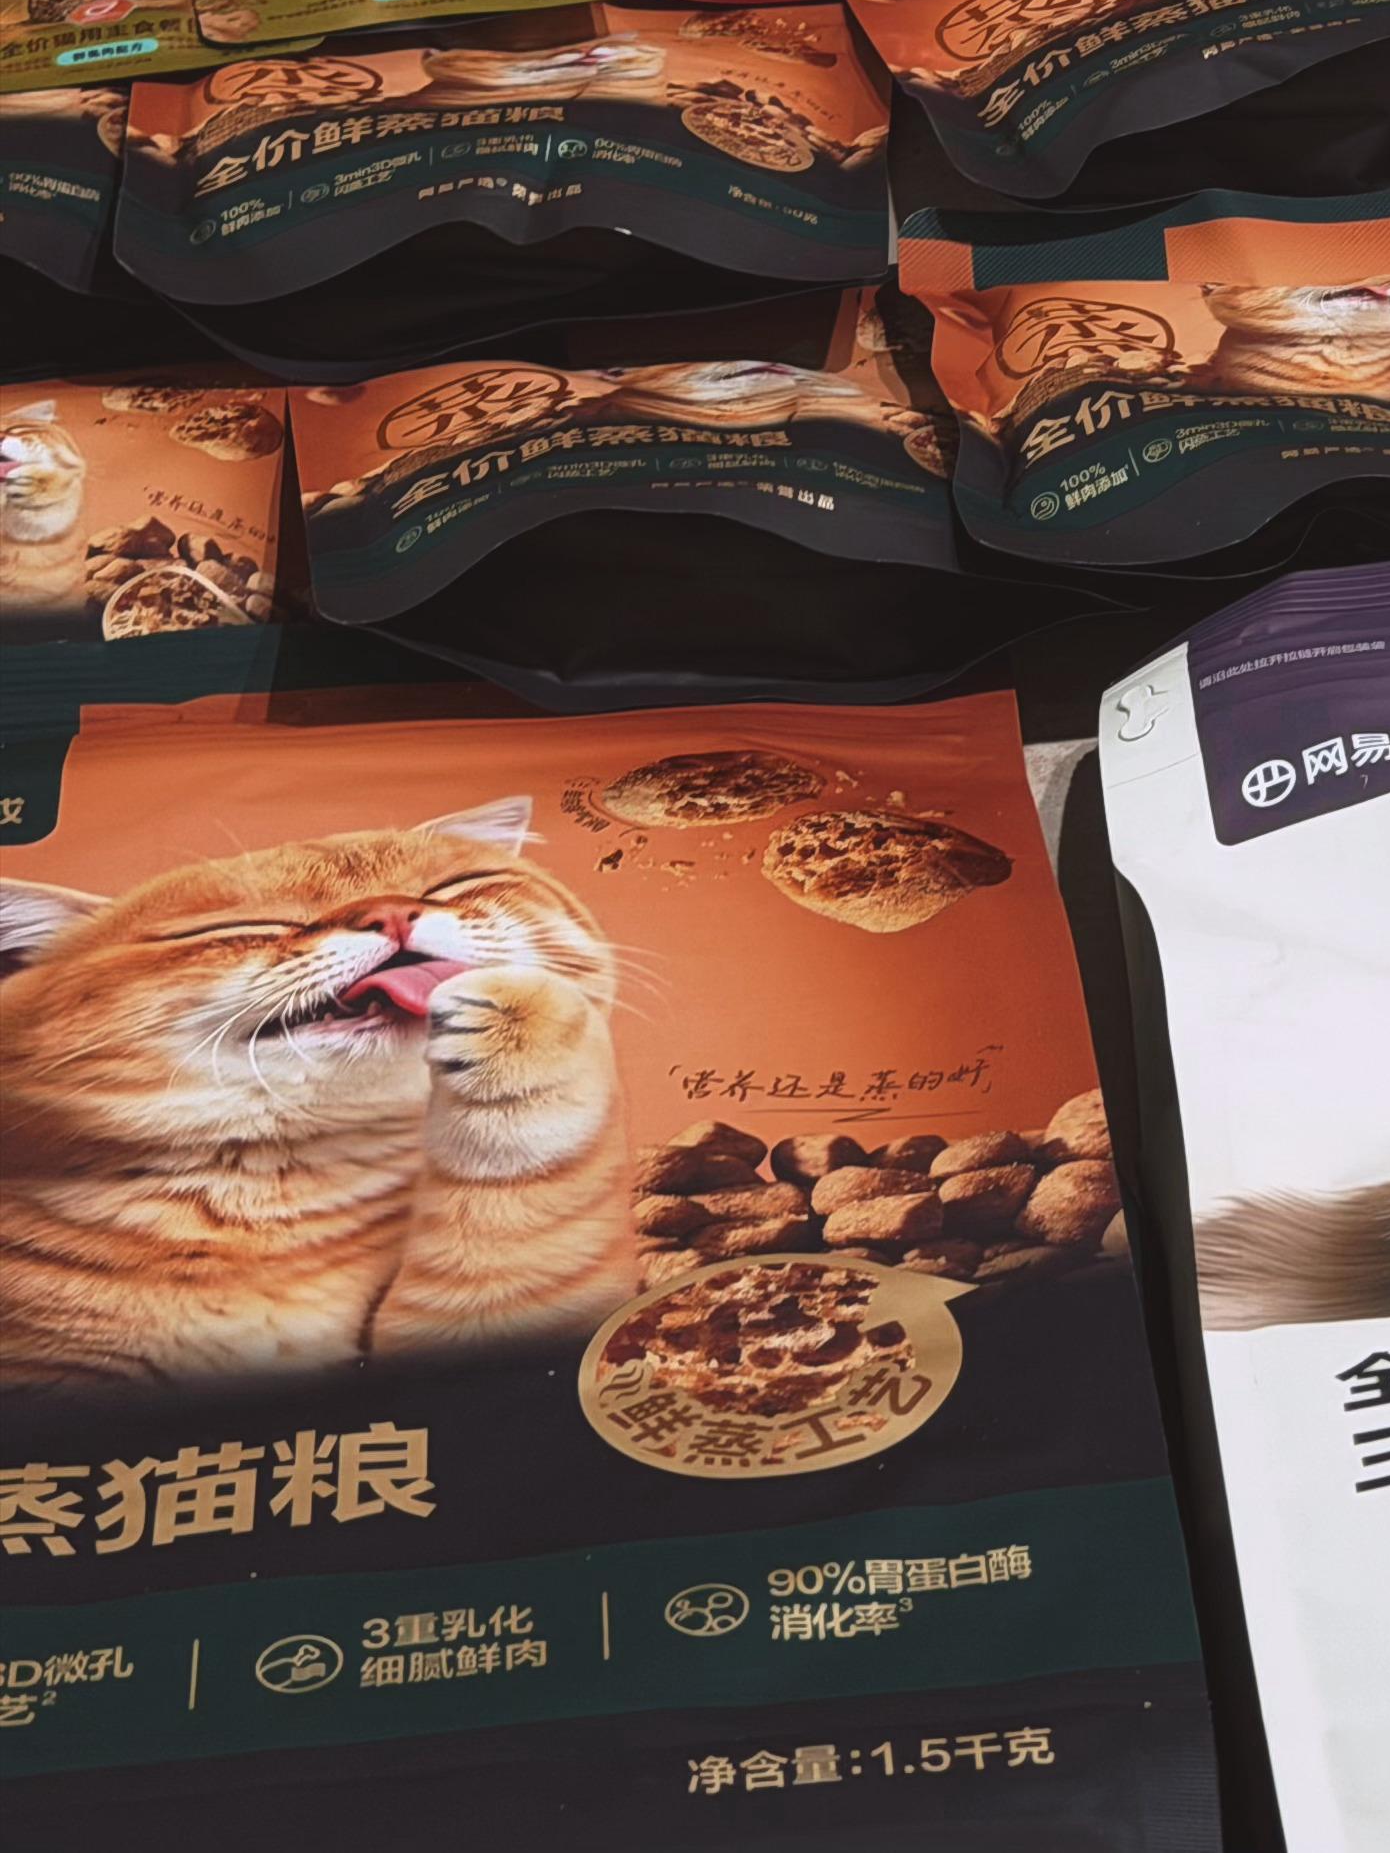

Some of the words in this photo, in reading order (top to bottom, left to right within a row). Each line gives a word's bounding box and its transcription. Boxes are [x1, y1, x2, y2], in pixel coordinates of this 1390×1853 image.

[1, 16, 196, 60] 全价猫用主食餐
[1059, 463, 1107, 492] 100%
[606, 1366, 933, 1468] 鲜蒸工艺
[768, 1543, 1034, 1597] 90%胃蛋白酶
[362, 1604, 534, 1650] 3重乳化
[0, 1646, 134, 1688] D微孔
[360, 1640, 548, 1688] 细腻鲜肉
[687, 1726, 1057, 1795] 净含量:1.5千克
